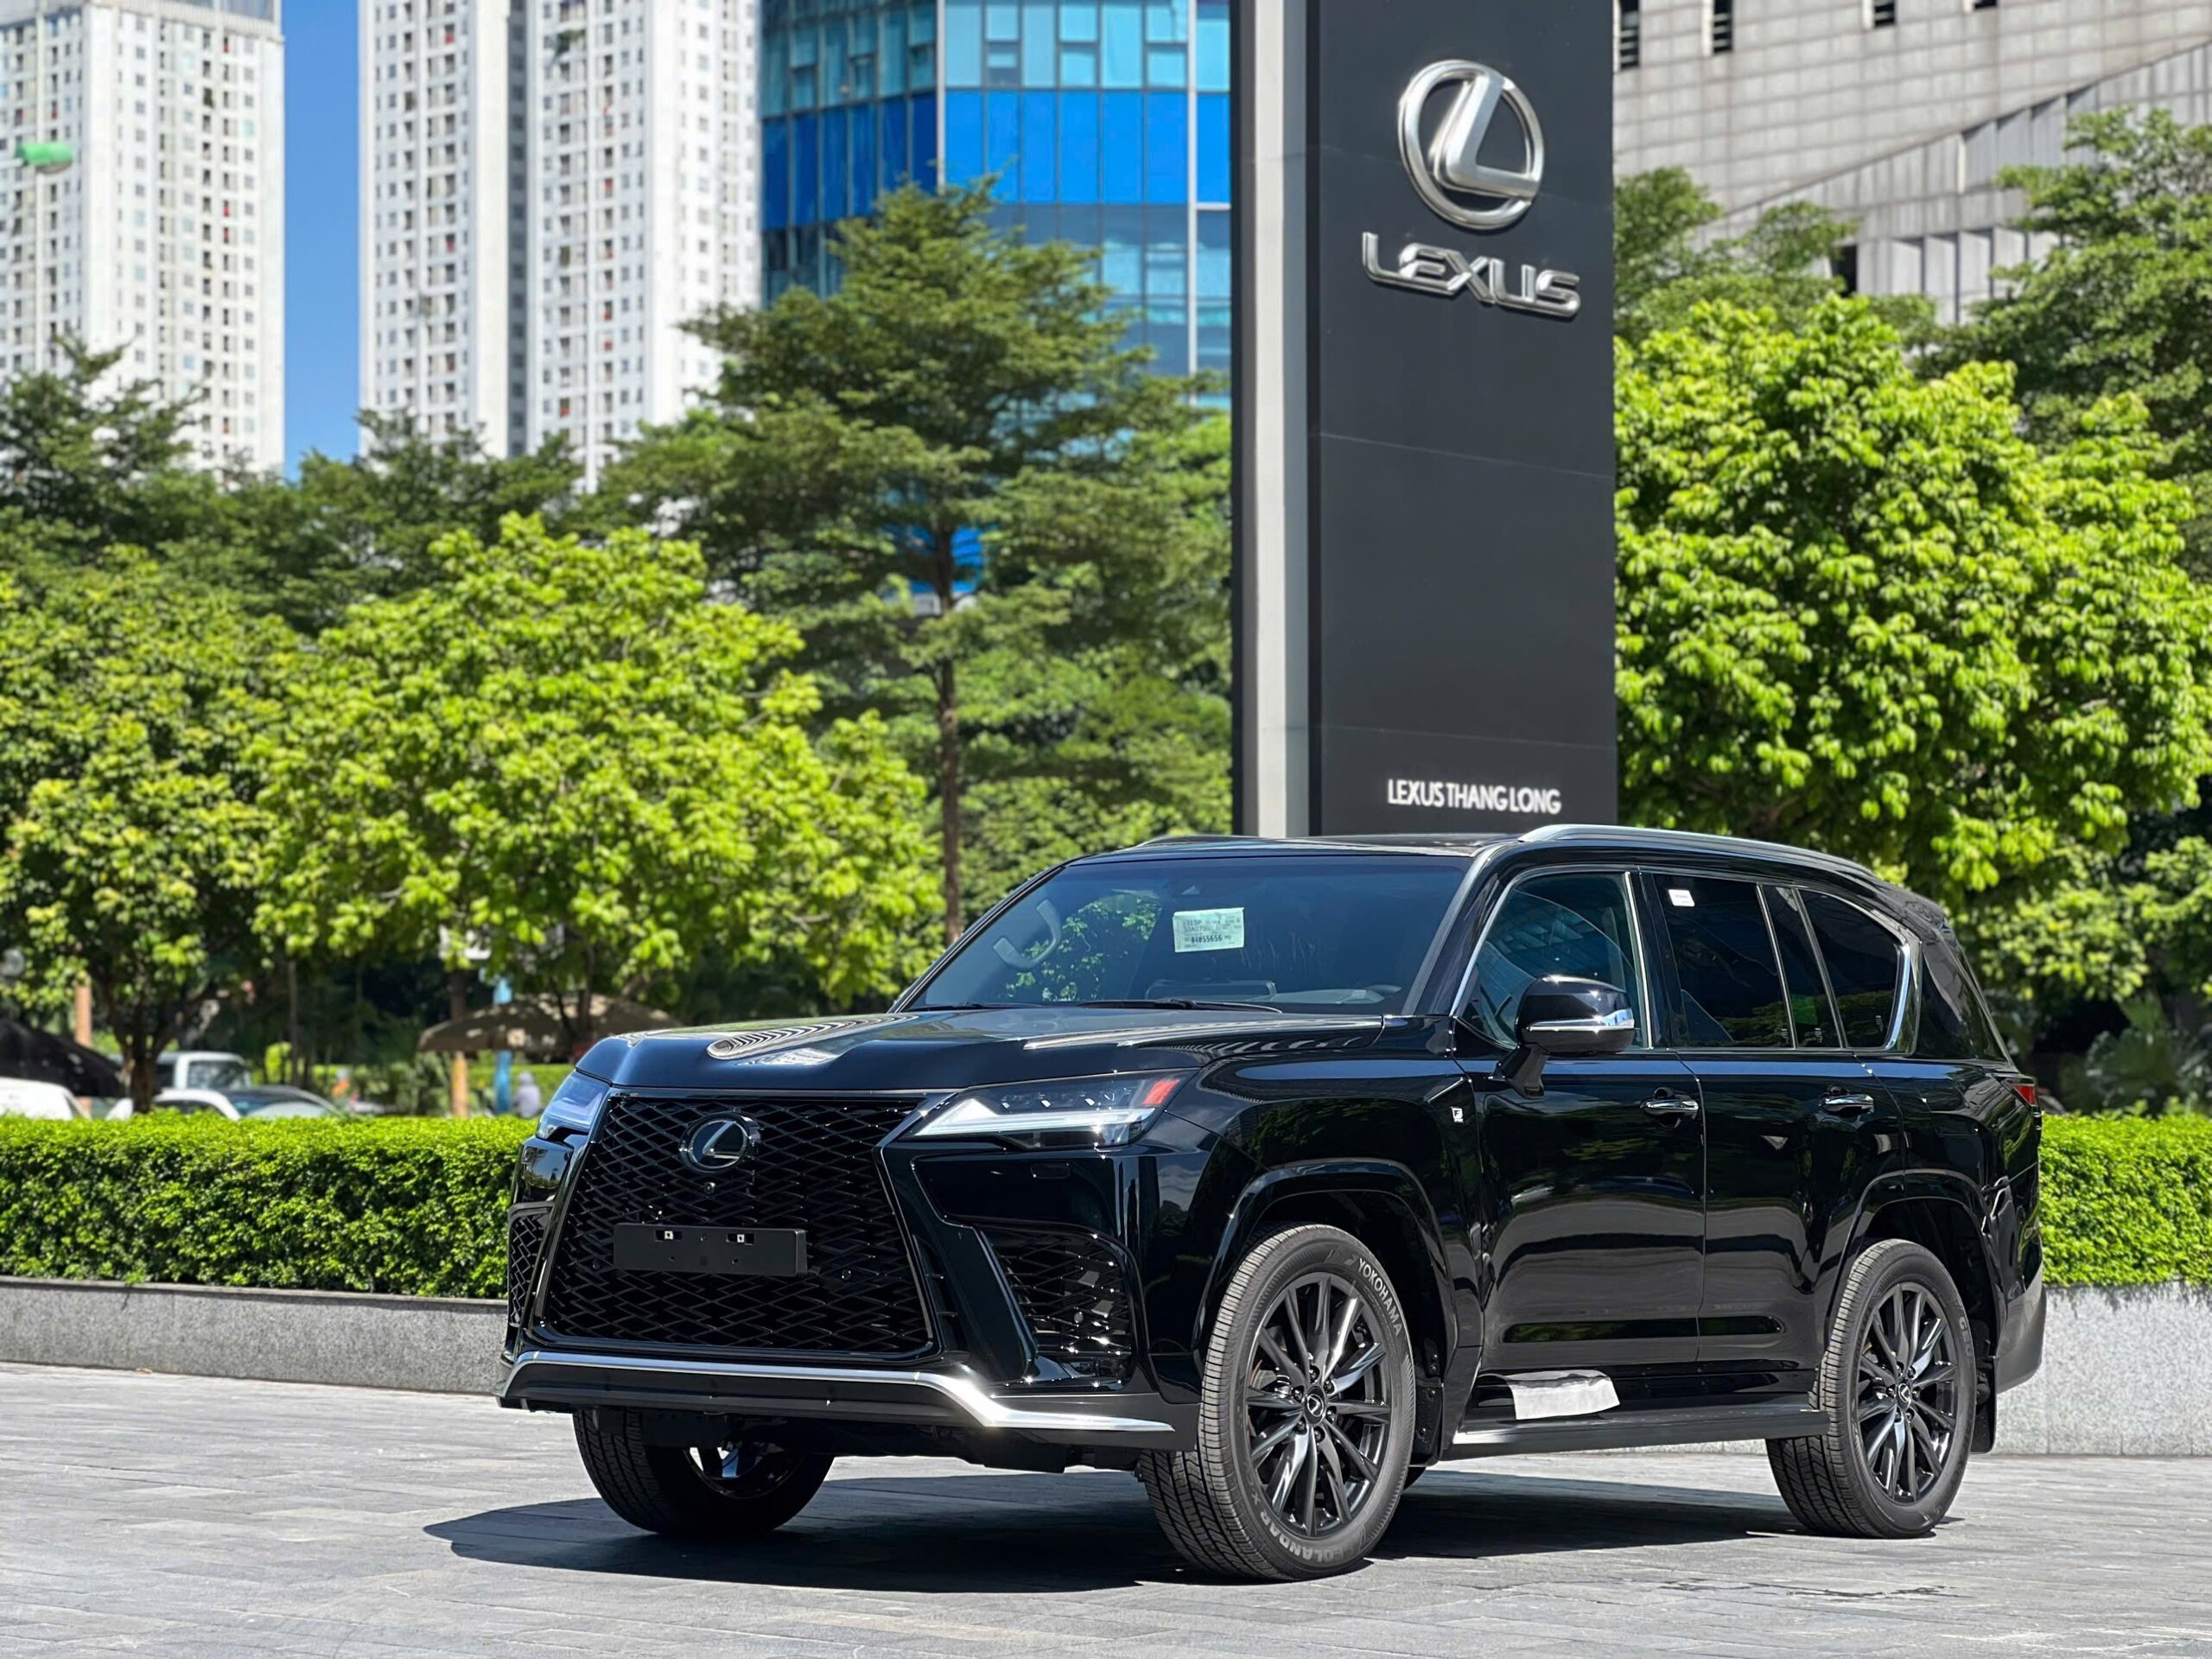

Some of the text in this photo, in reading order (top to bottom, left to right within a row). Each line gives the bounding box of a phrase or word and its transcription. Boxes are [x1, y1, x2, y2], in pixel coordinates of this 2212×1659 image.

[1362, 232, 1581, 318] LEXUS
[1388, 779, 1445, 808] LEXUS
[1357, 1257, 1403, 1337] YOKOHAMA
